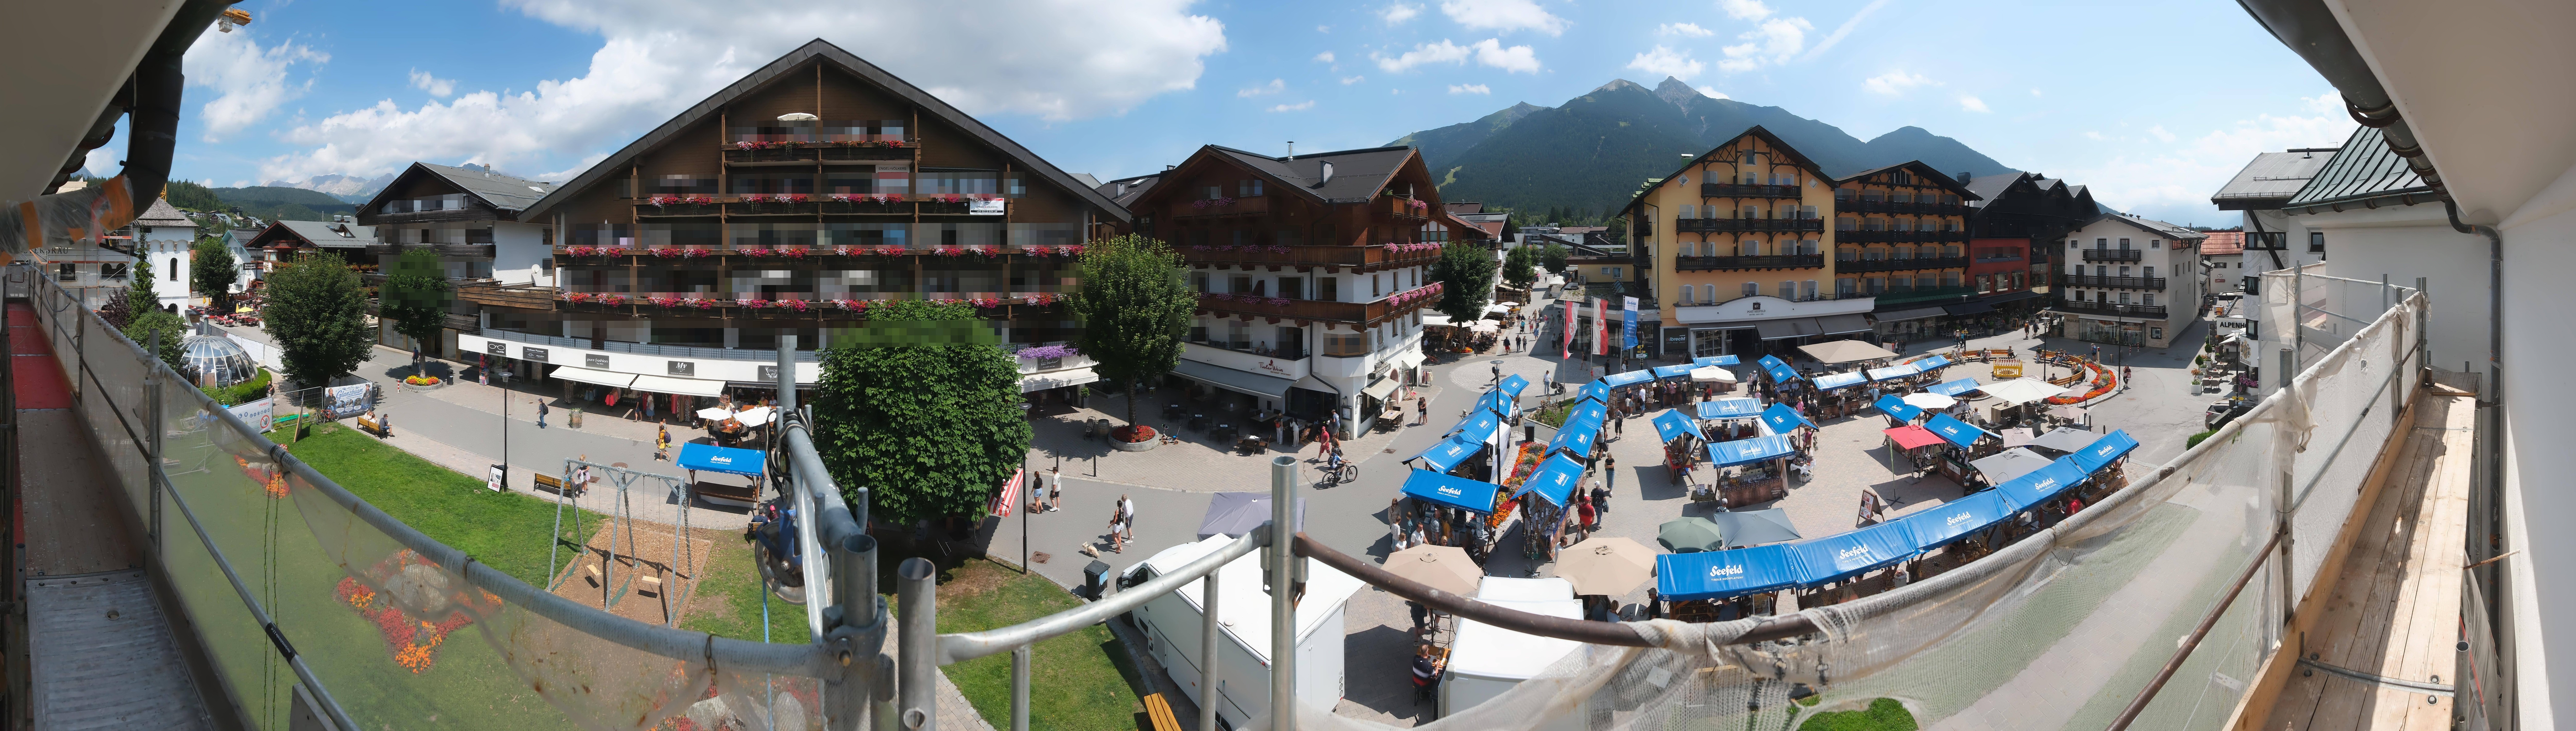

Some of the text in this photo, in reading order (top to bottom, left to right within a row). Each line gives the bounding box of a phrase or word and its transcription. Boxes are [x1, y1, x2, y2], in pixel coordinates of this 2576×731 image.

[1376, 365, 1390, 378] RESTAURANT
[336, 388, 363, 401] Glanzbuam
[1447, 446, 1461, 455] Seefeld
[2098, 445, 2113, 455] Seefeld
[1555, 472, 1566, 485] Seefeld
[2035, 477, 2054, 490] Seefeld
[1438, 485, 1461, 495] Seefeld
[1947, 511, 1971, 525] Seefeld
[1840, 543, 1868, 559] Seefeld
[1710, 564, 1743, 576] Seefeld
